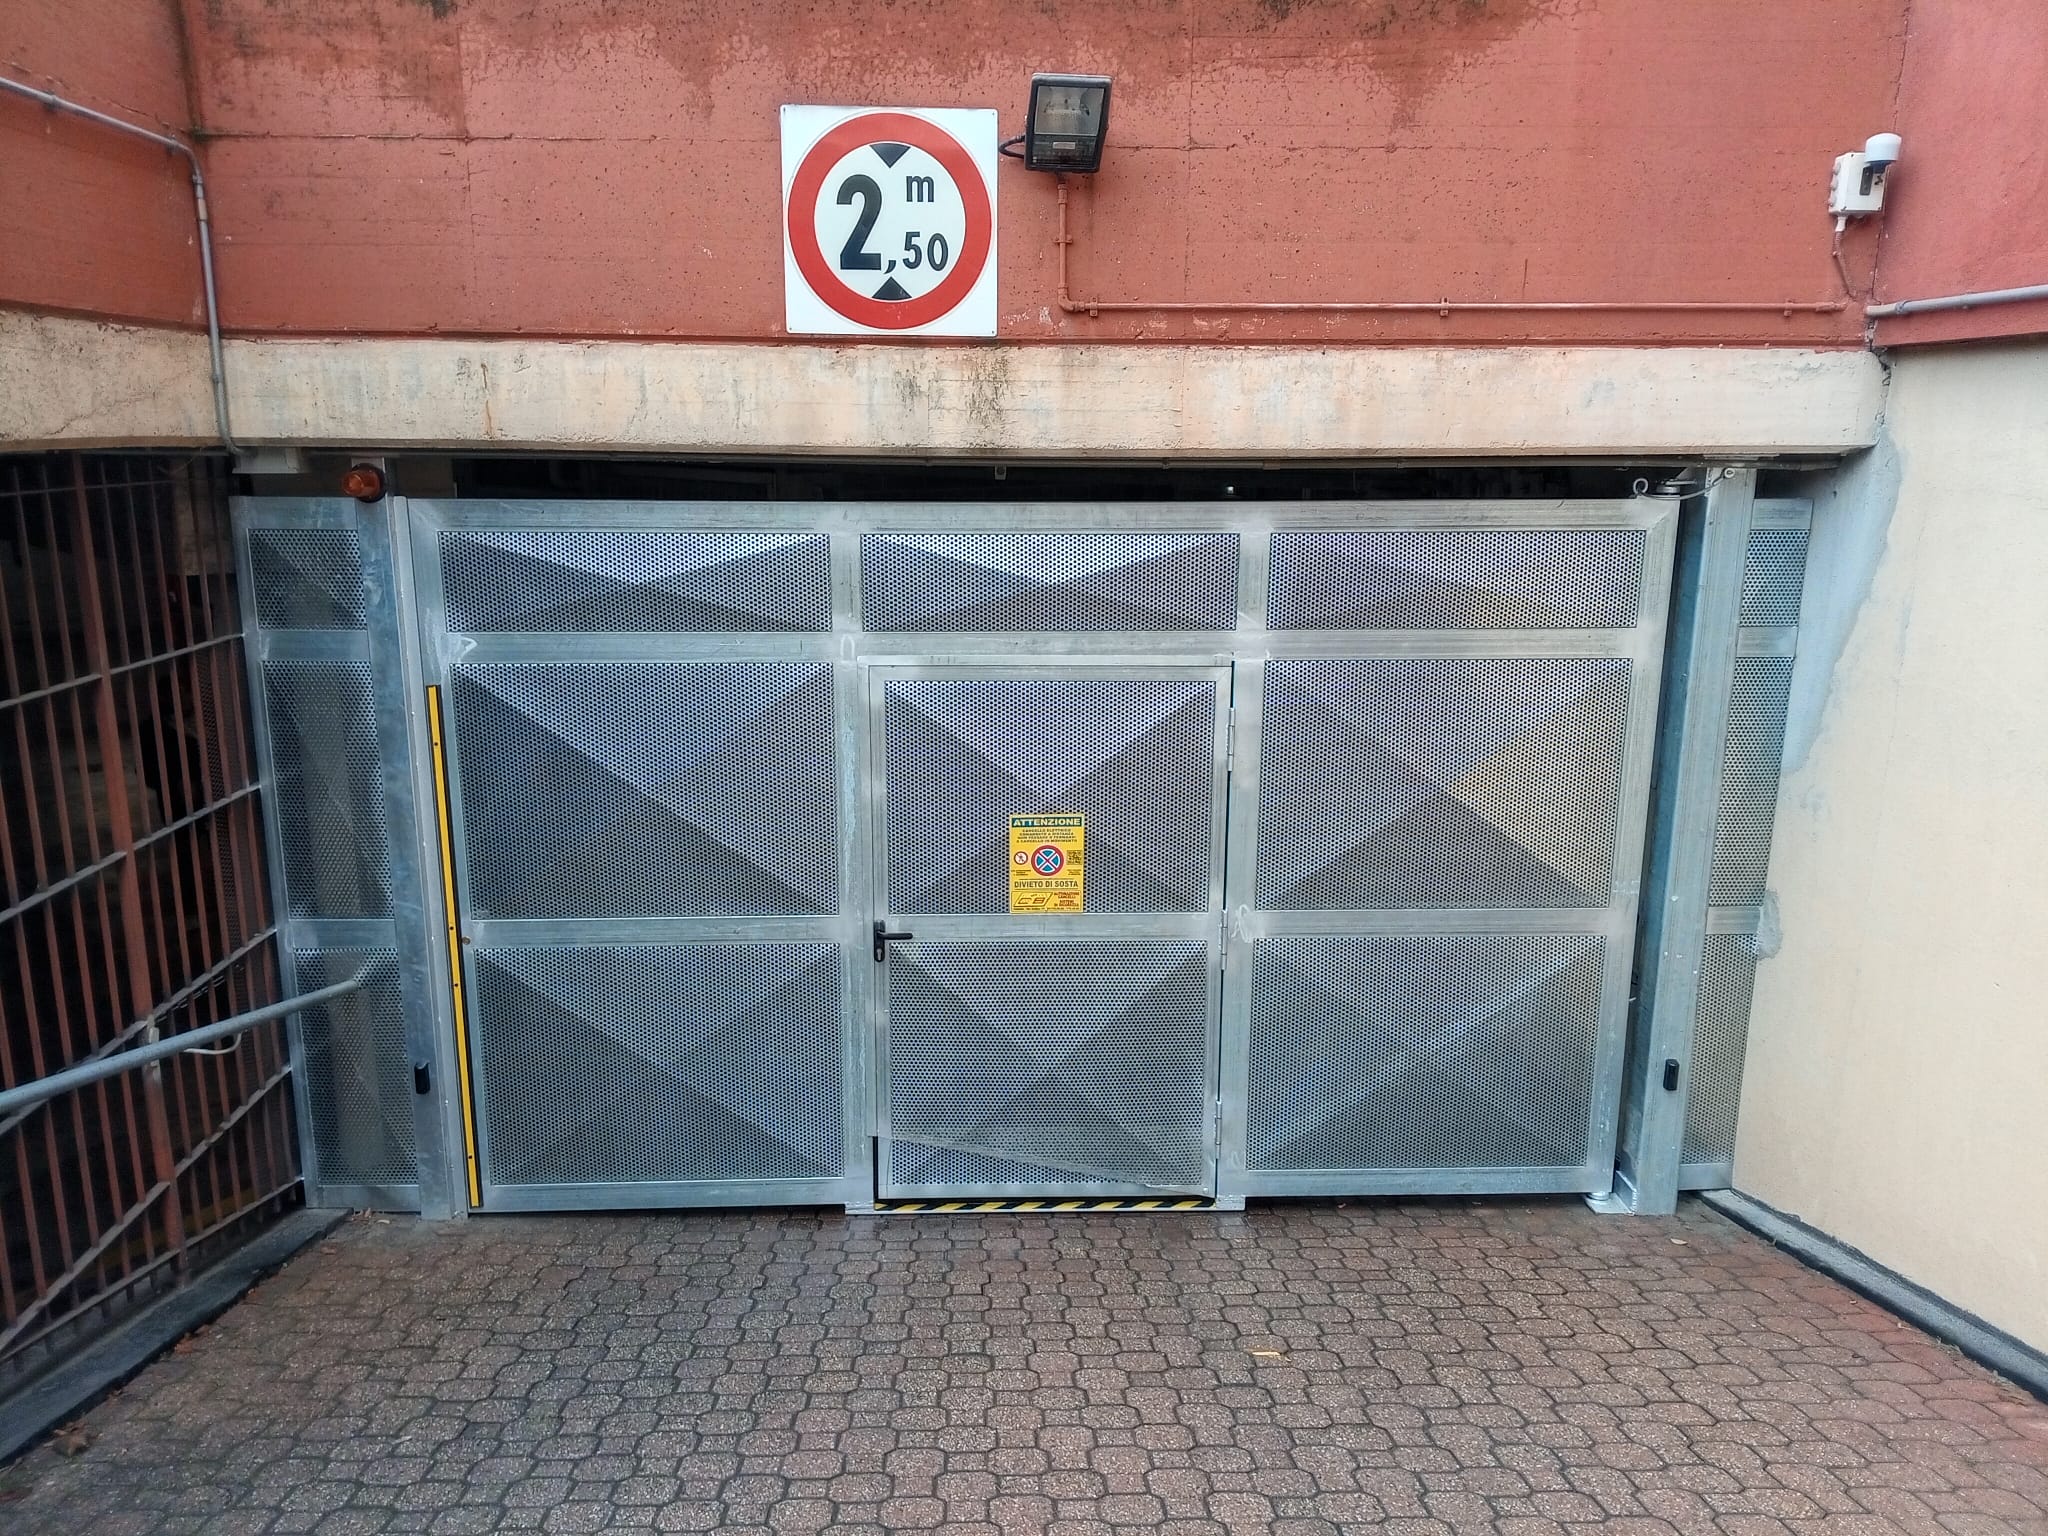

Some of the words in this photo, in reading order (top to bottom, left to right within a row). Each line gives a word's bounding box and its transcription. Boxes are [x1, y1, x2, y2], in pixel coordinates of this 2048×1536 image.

[906, 175, 935, 203] m
[1013, 818, 1081, 827] ATTENZIONE
[1014, 880, 1043, 888] DIVIETO
[1045, 880, 1053, 888] DI
[1055, 880, 1079, 888] SOSTA
